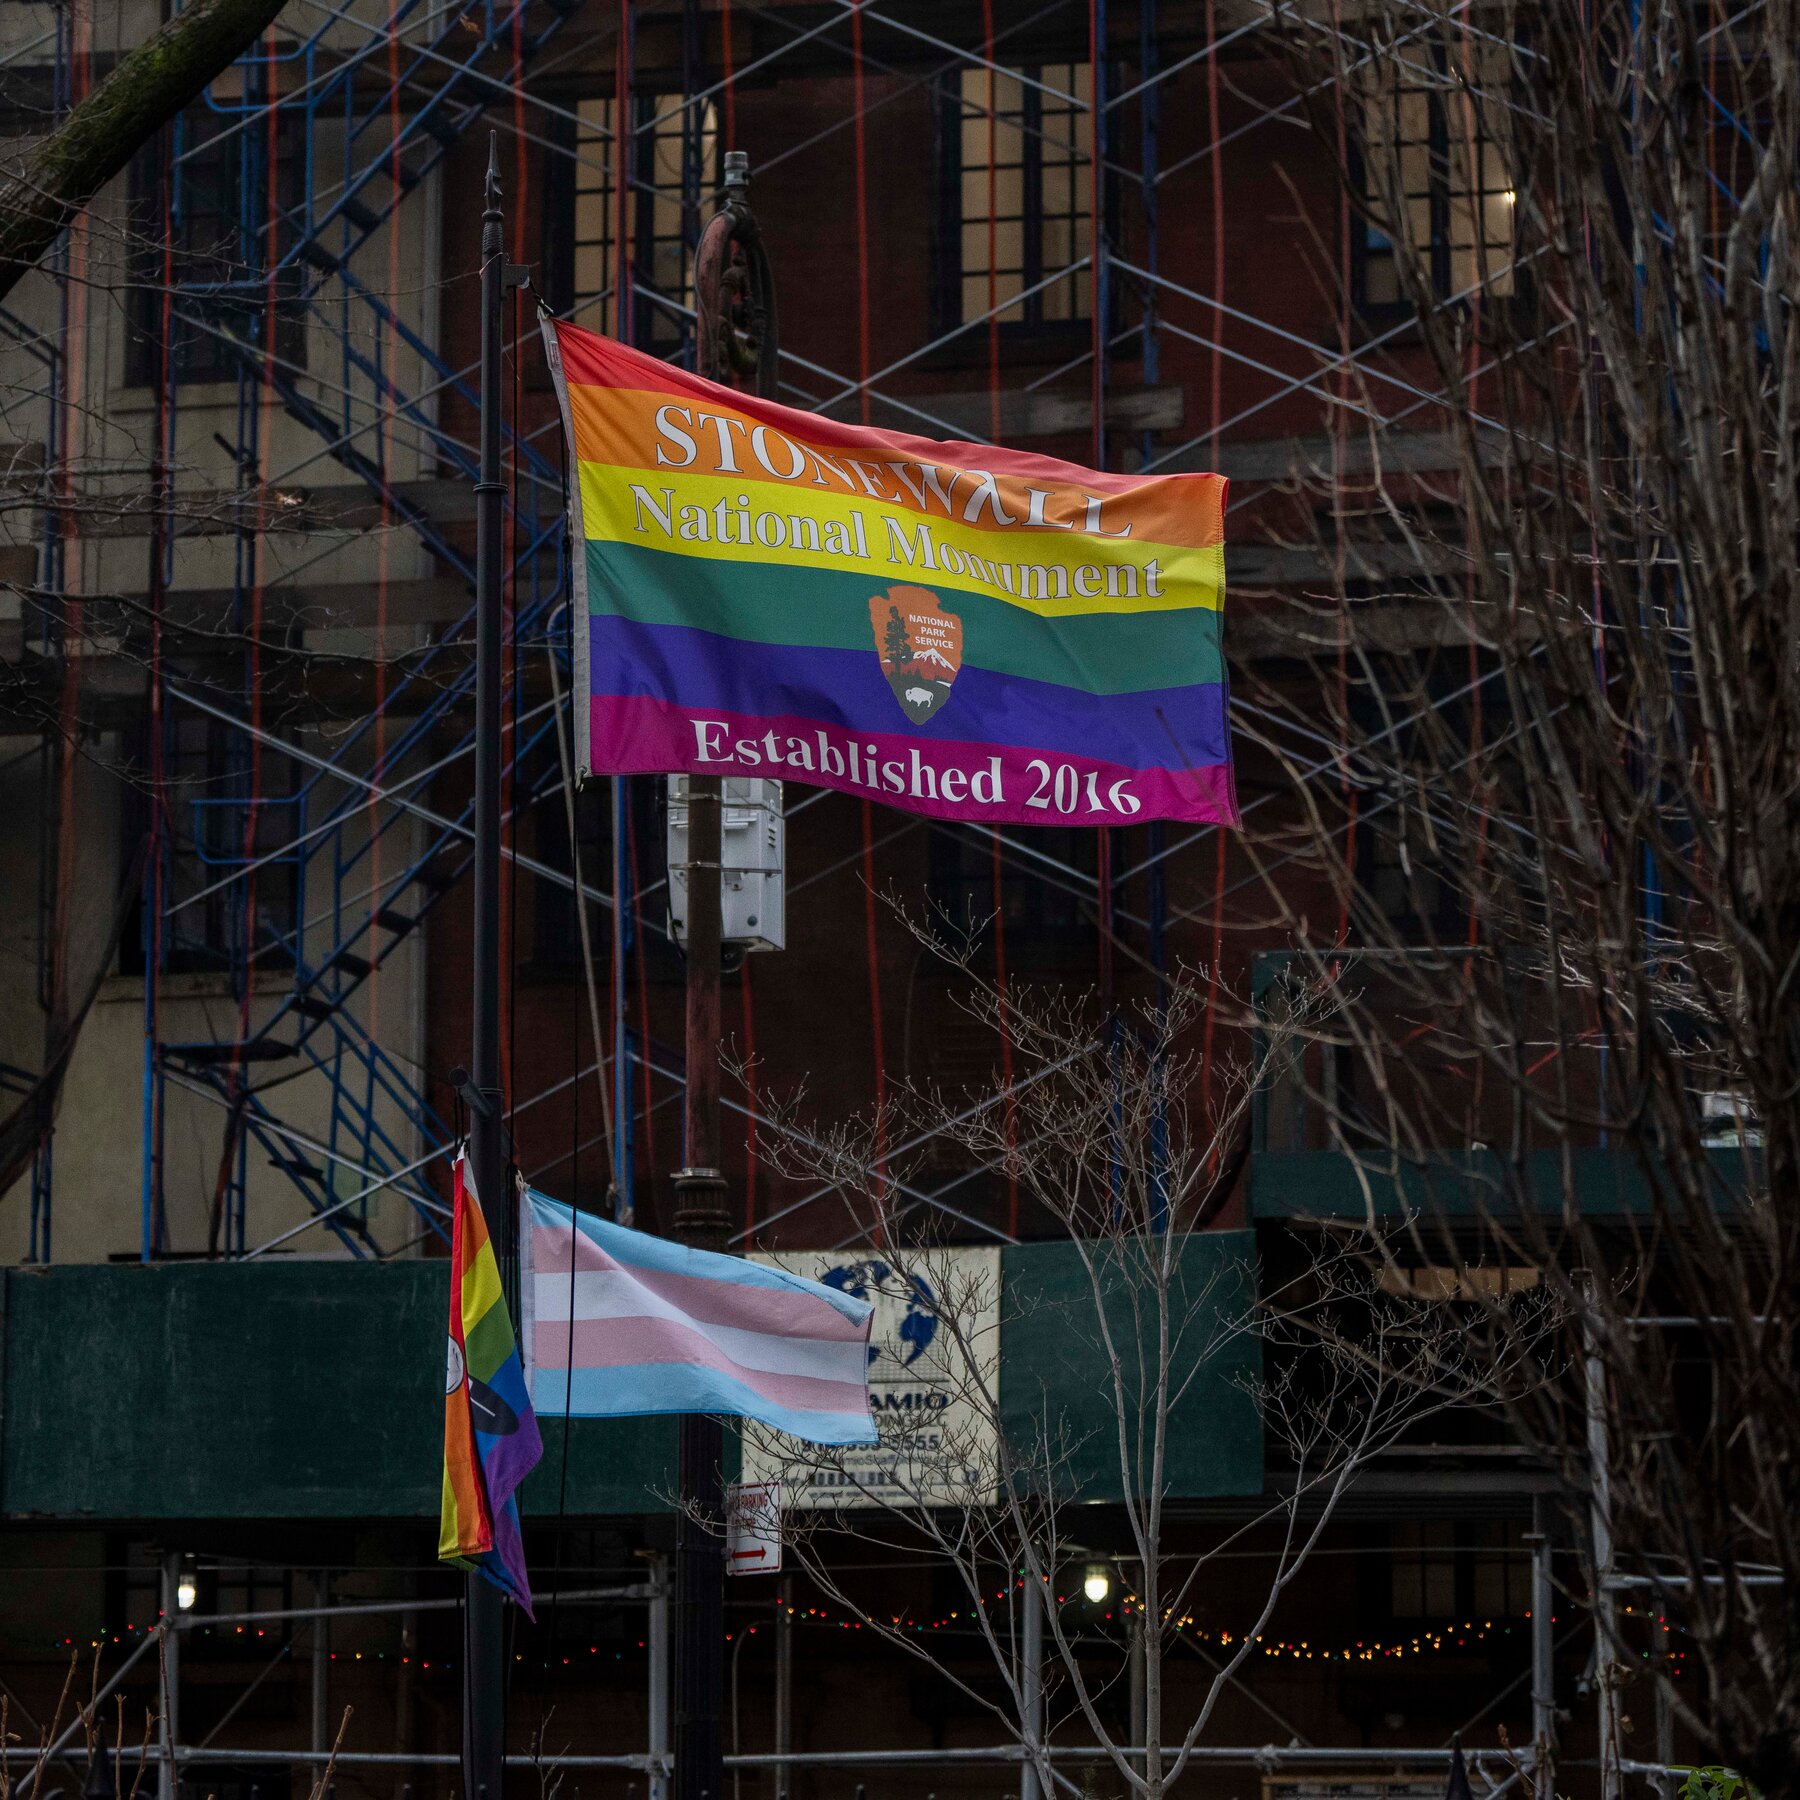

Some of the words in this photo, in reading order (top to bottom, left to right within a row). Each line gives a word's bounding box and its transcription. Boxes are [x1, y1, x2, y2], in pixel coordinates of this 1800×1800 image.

[655, 404, 1133, 537] STONEWALL
[628, 484, 871, 558] National
[881, 515, 1166, 600] Monument
[908, 614, 956, 629] NATIONAL
[914, 636, 954, 649] SERVICE
[920, 626, 946, 638] PARK
[689, 719, 1006, 804] Established
[1025, 759, 1141, 815] 2016
